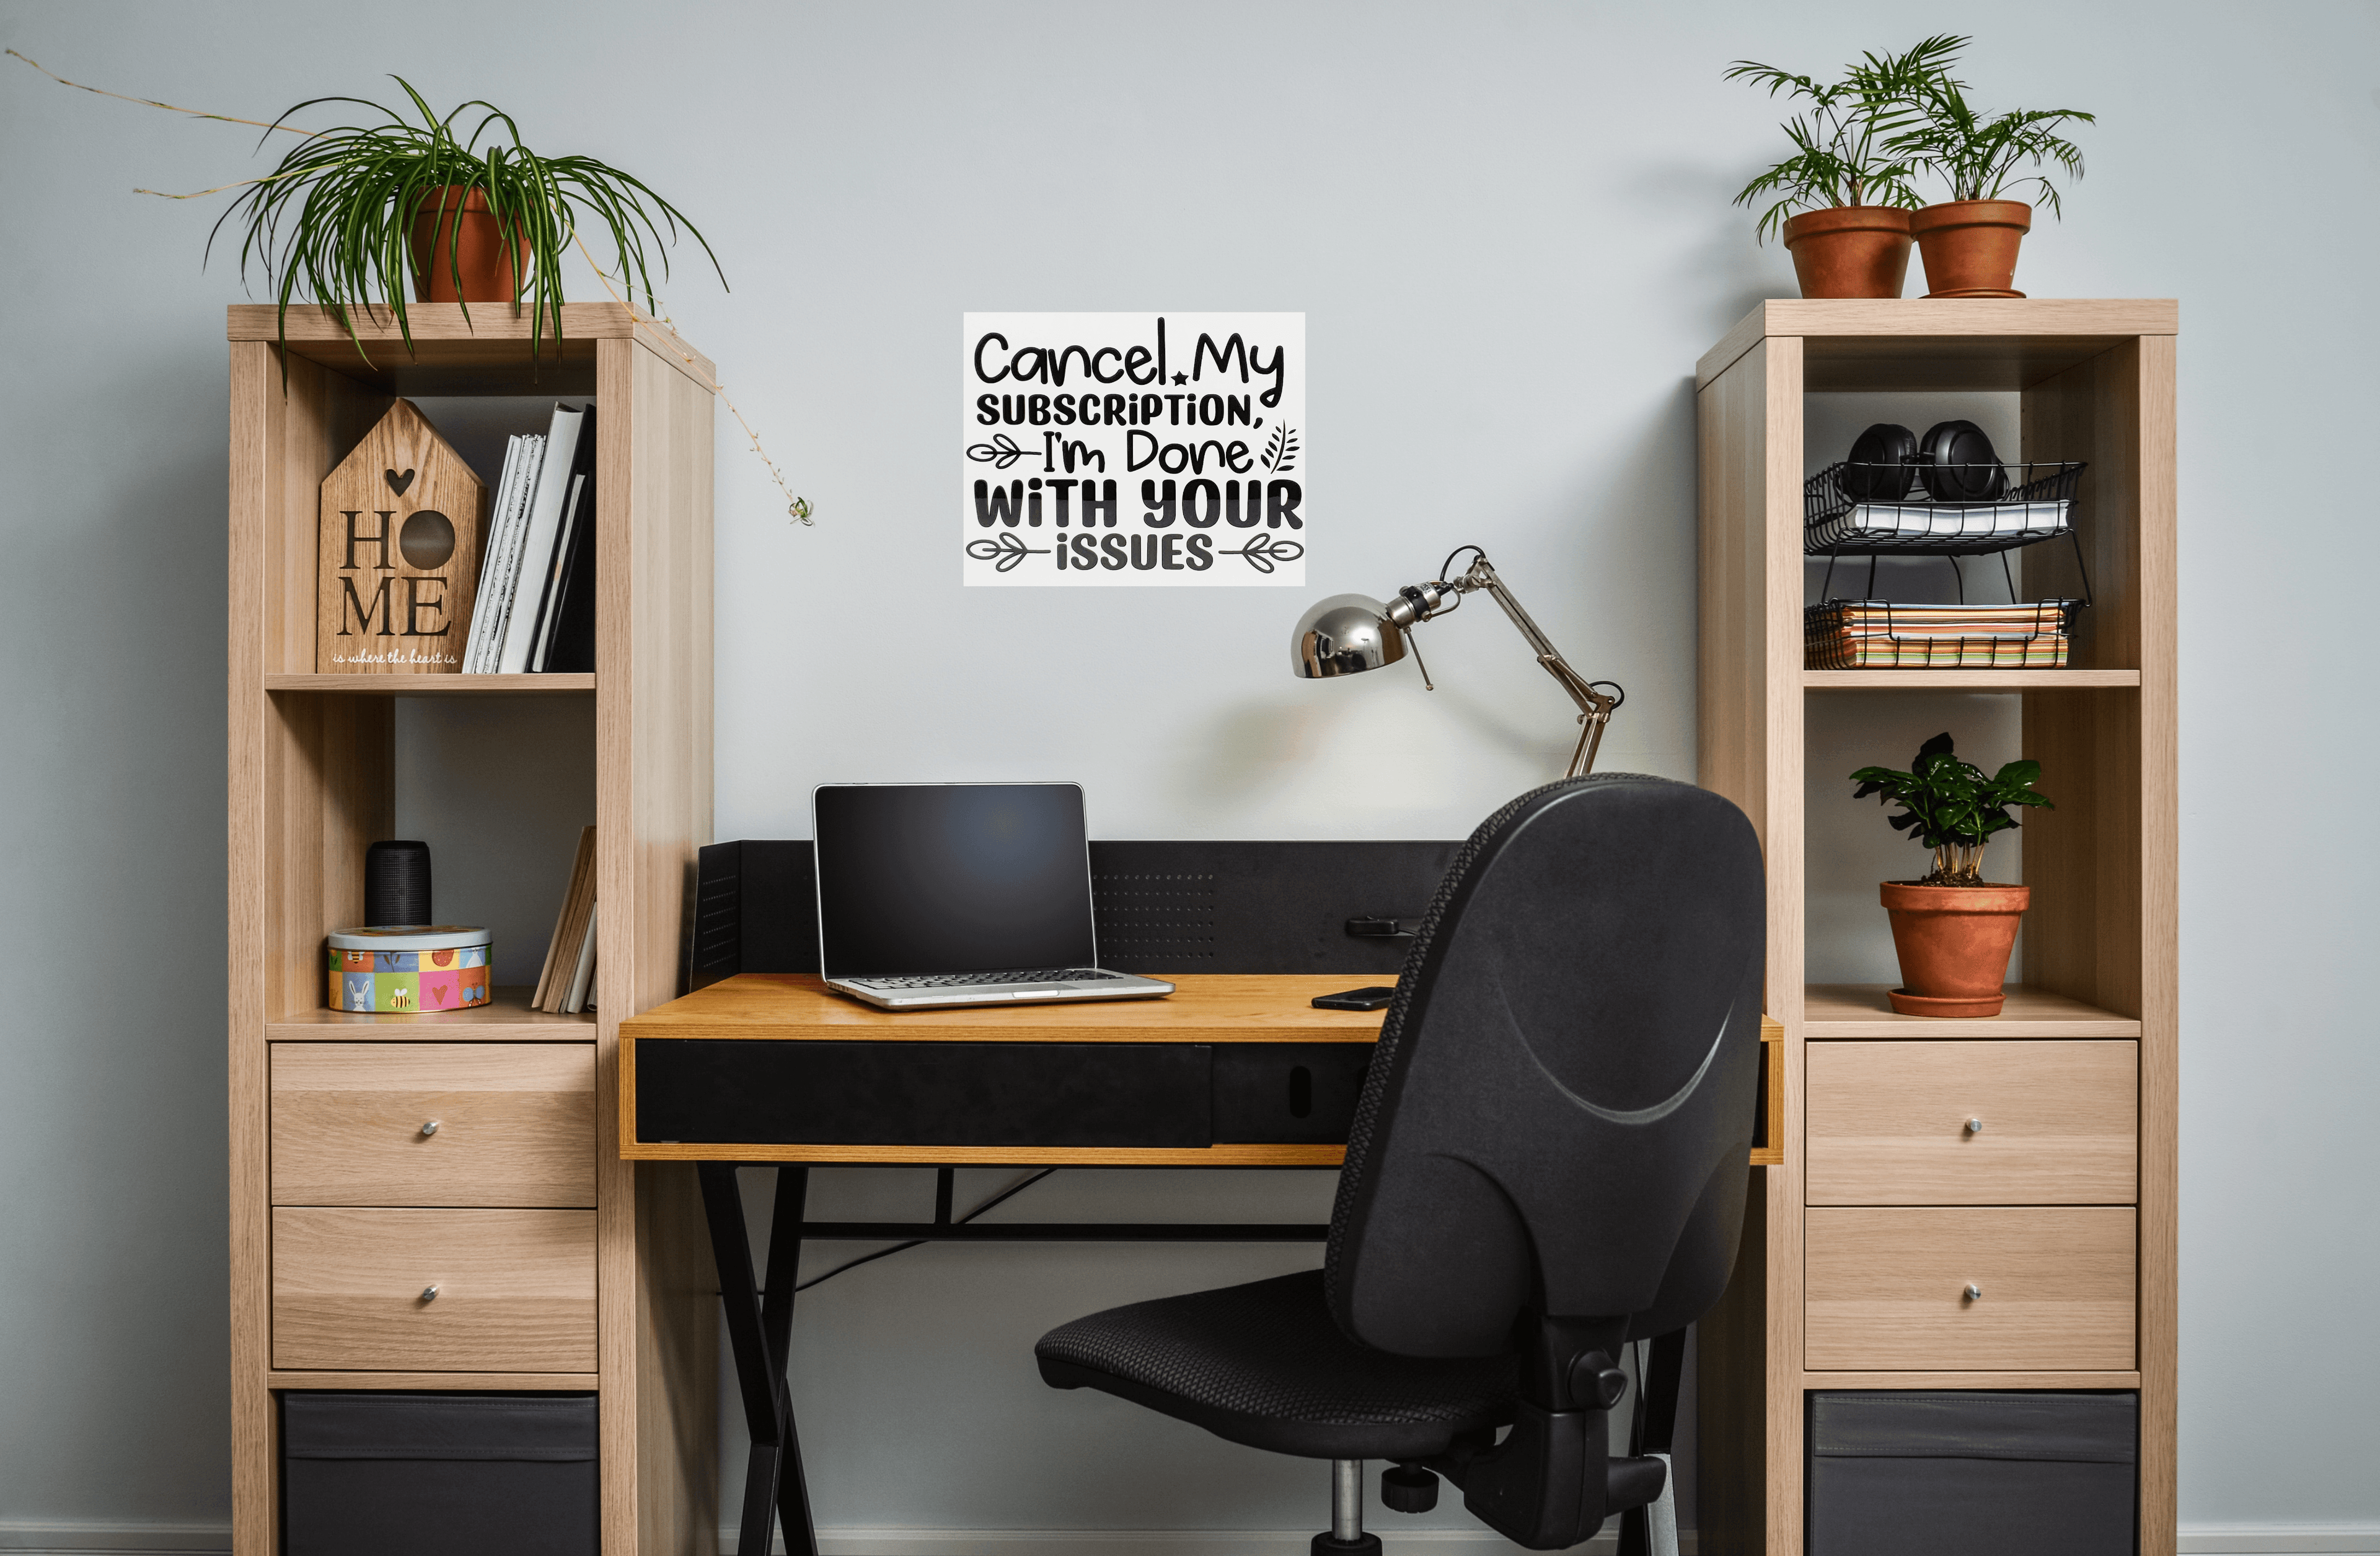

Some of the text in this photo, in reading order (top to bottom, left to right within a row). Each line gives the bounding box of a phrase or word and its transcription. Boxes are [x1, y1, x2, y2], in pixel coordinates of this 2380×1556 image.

[974, 317, 1284, 408] Cancel My
[1042, 429, 1254, 475] I'm Done
[332, 648, 458, 664] is where the heart is
